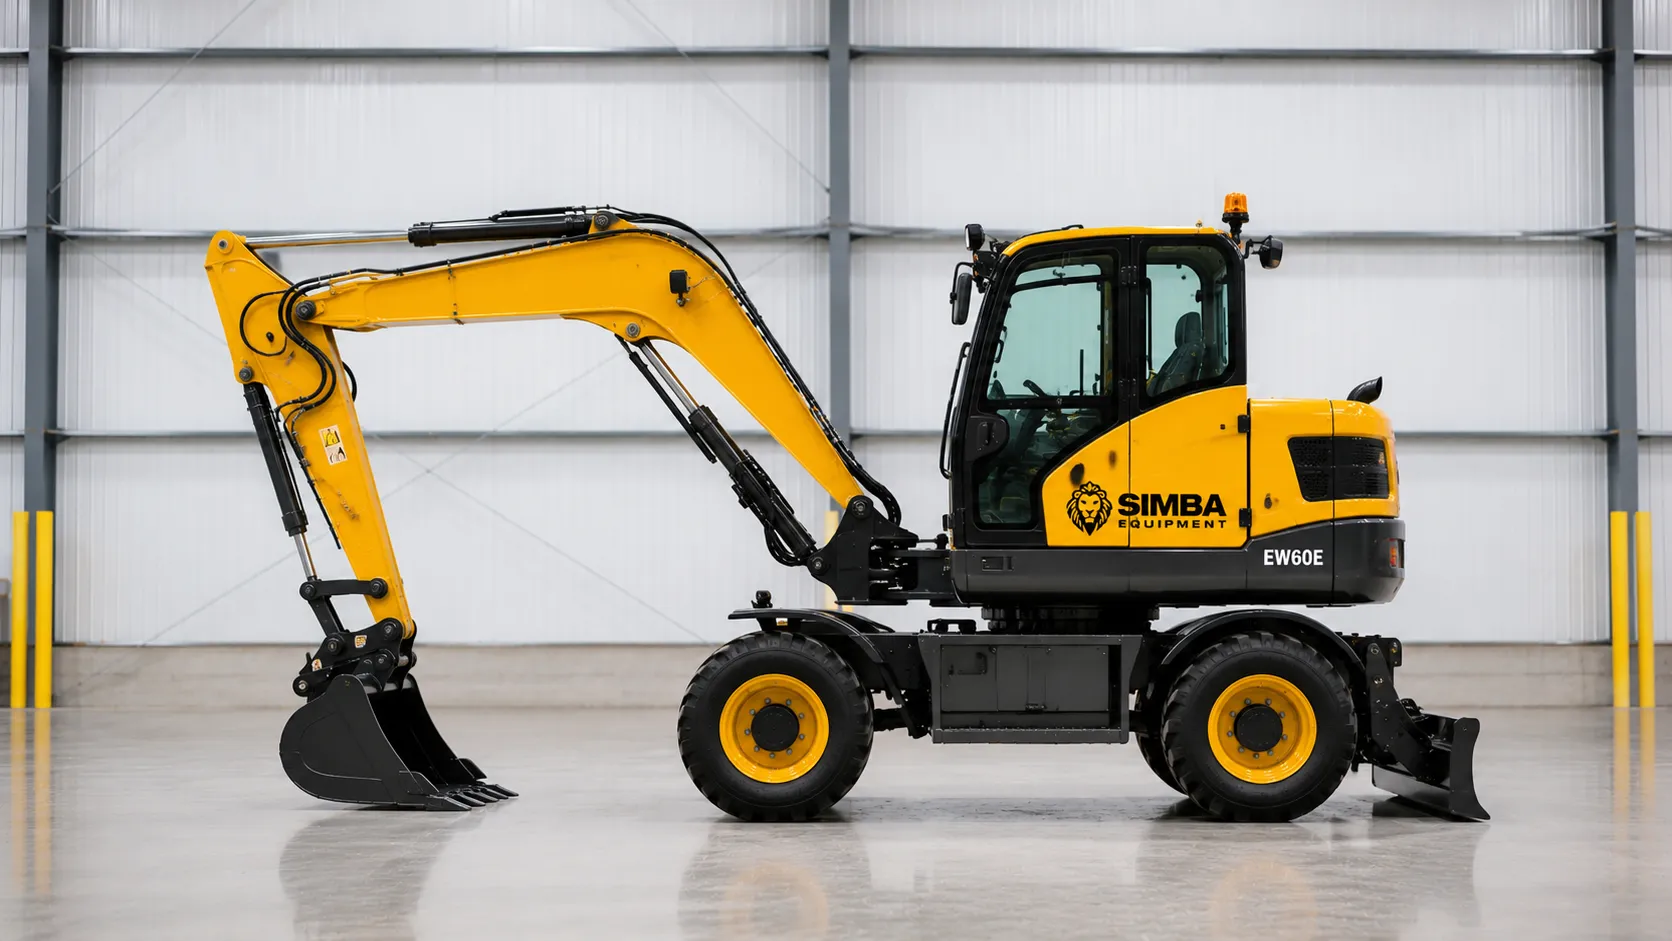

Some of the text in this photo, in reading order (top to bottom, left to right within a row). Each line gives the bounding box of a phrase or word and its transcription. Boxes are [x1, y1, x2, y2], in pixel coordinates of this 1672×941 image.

[1118, 493, 1226, 517] SIMBA
[1118, 519, 1227, 529] EQUIPMENT
[1263, 549, 1324, 566] EW60E
